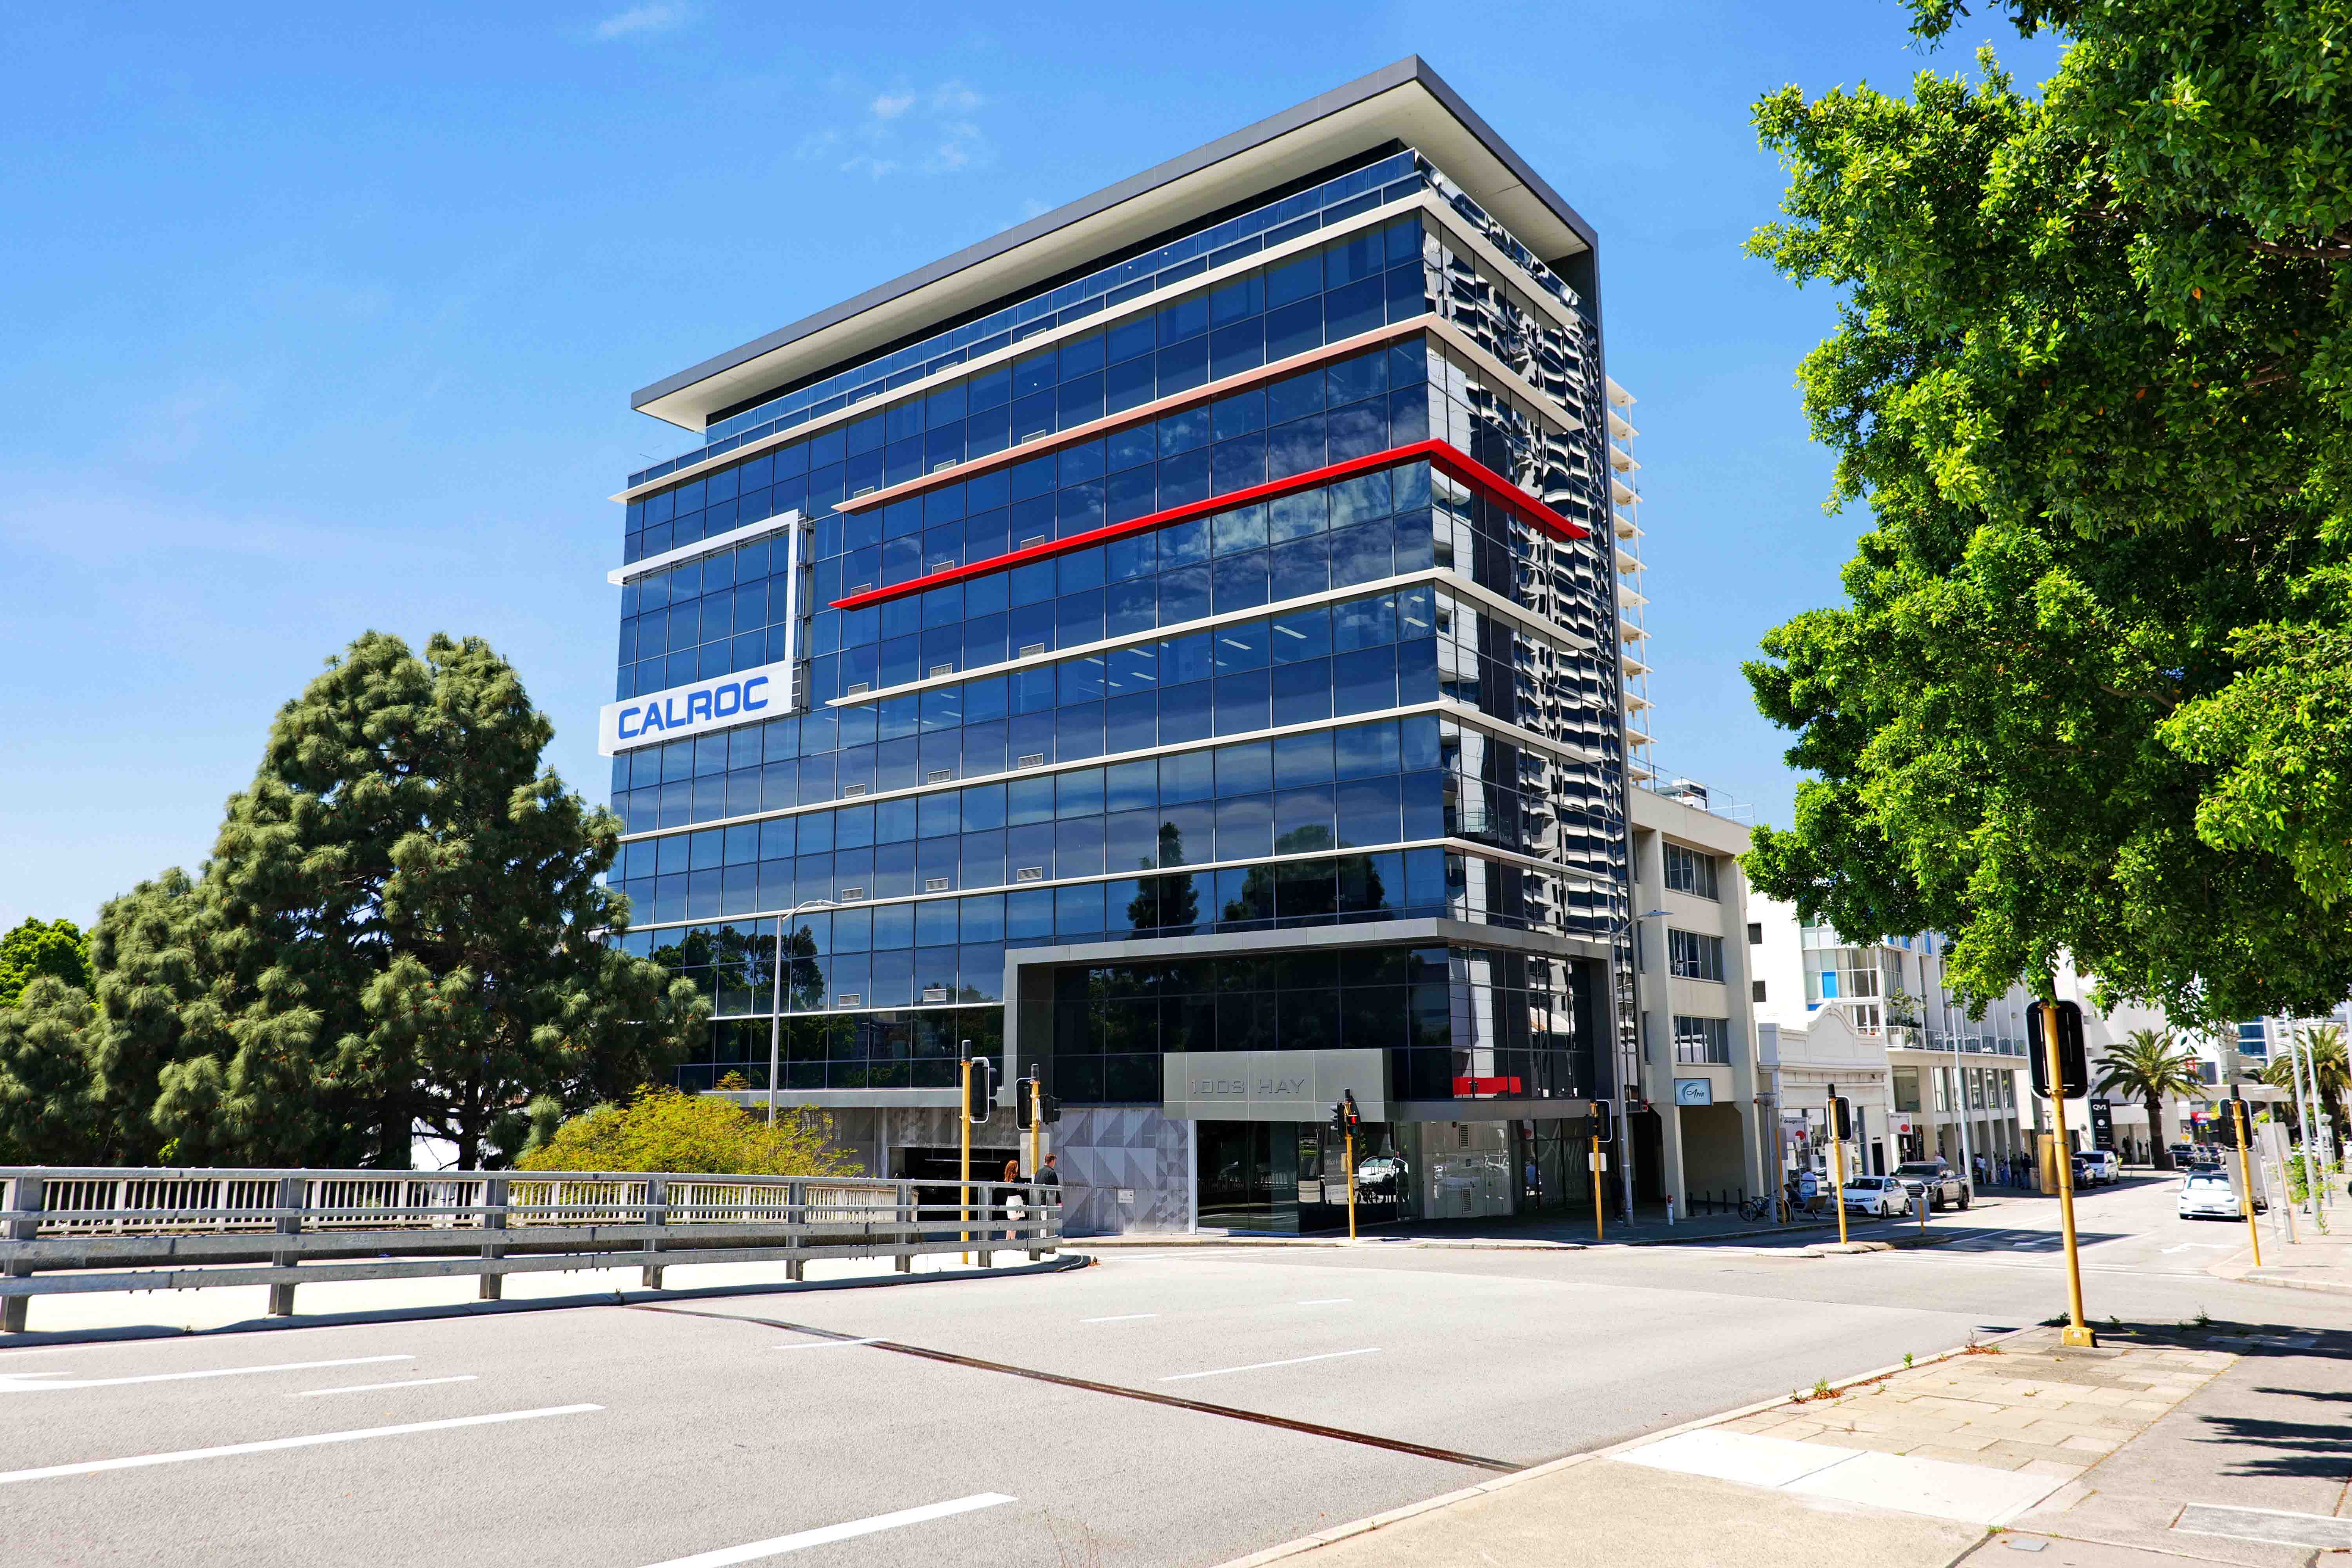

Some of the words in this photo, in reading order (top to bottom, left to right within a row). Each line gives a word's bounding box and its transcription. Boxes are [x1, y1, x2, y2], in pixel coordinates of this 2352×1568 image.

[618, 676, 769, 740] CALROC
[1191, 1078, 1245, 1094] 1008
[1257, 1078, 1305, 1094] HAY
[1686, 1089, 1704, 1099] Aria
